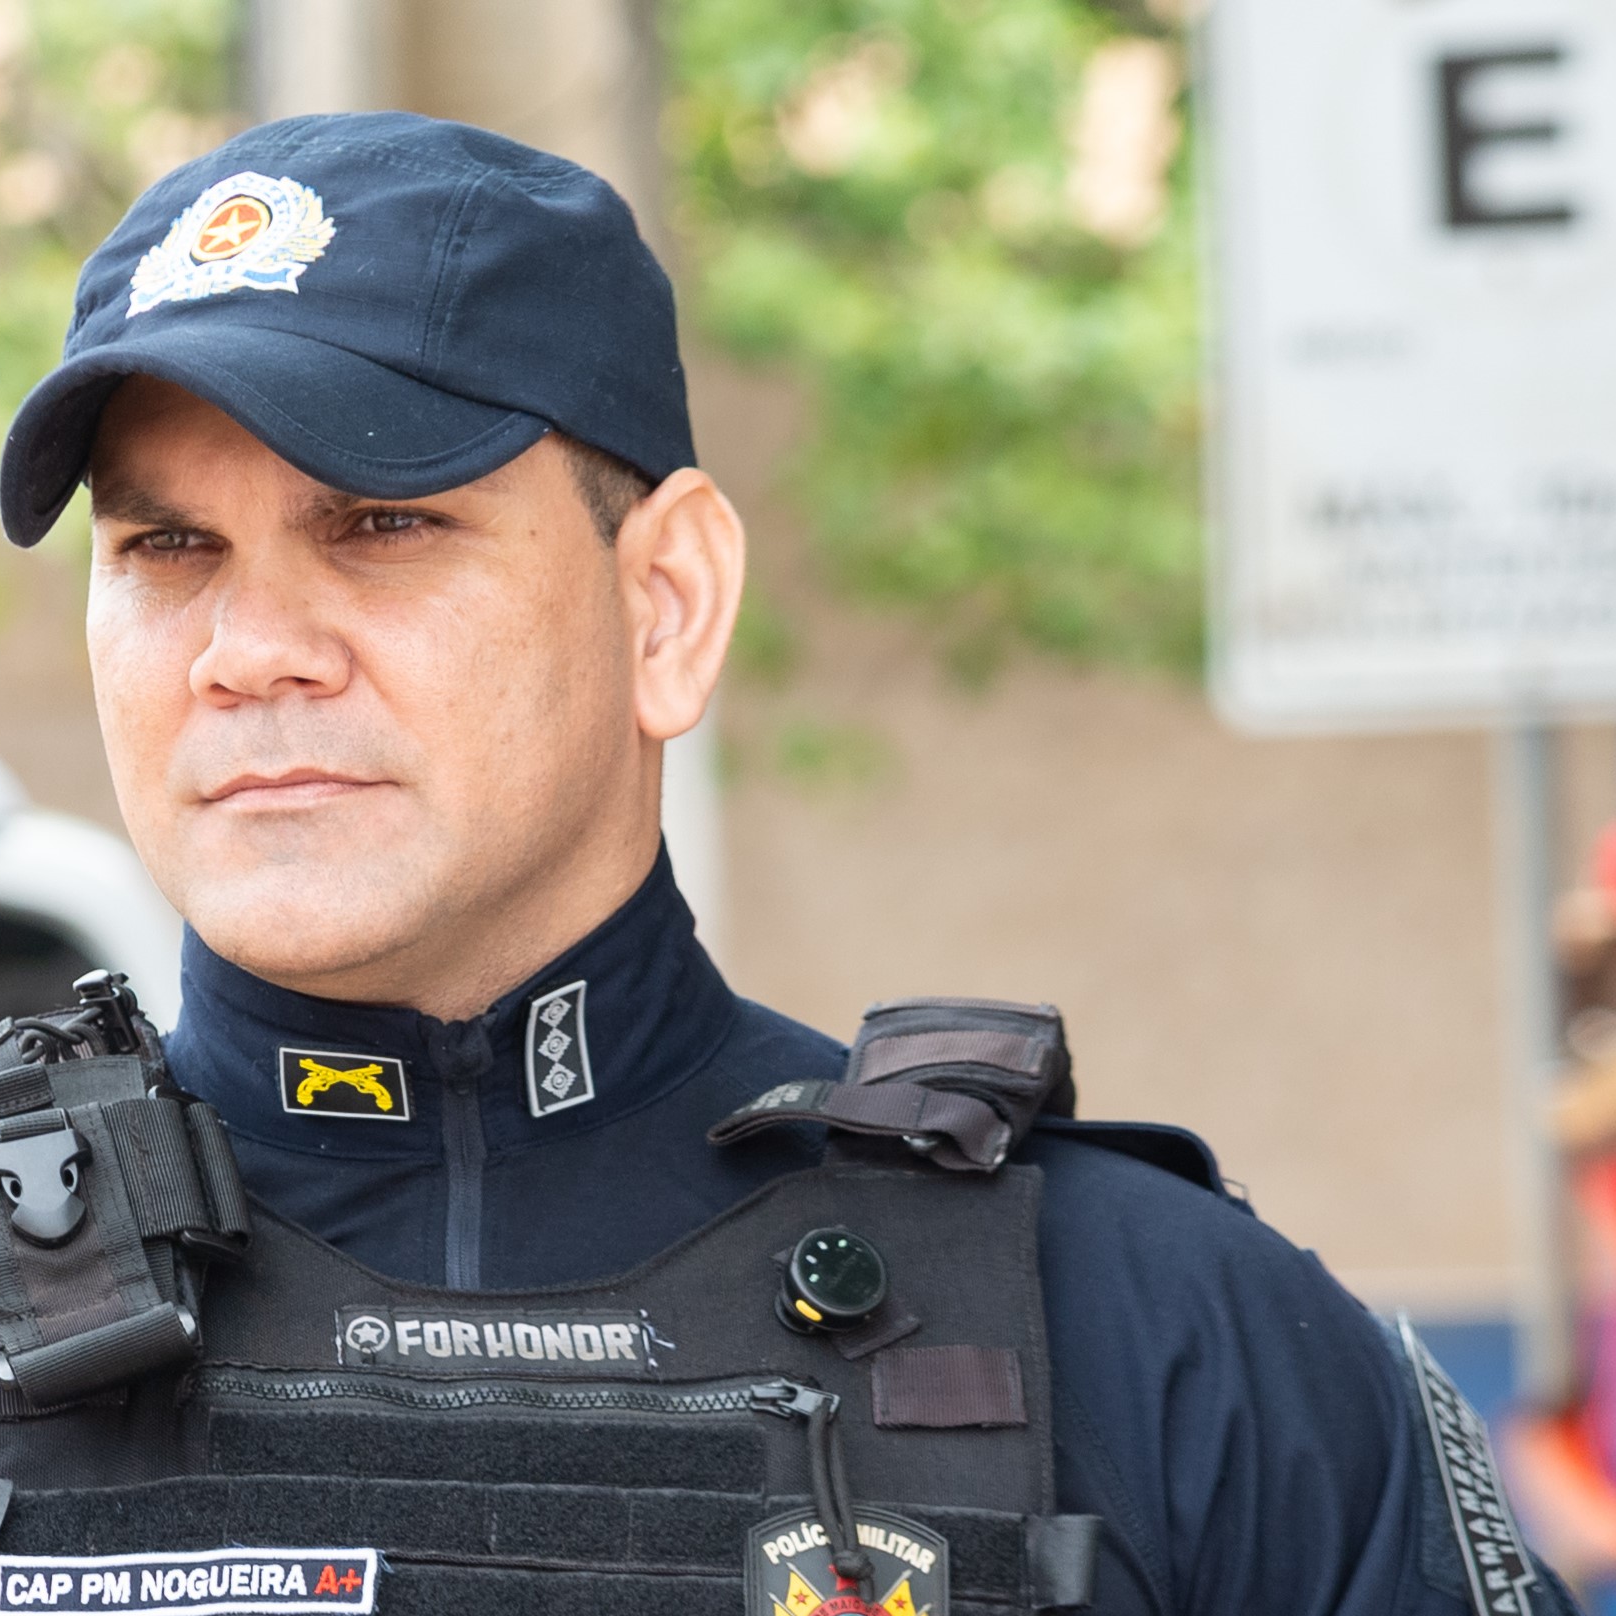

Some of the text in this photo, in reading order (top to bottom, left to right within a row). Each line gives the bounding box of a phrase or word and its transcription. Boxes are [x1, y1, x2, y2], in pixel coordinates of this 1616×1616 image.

[1437, 46, 1579, 229] E
[762, 1522, 936, 1575] POLÍC MILITAR
[6, 1564, 363, 1606] CAP PM NOGUEIRA A+
